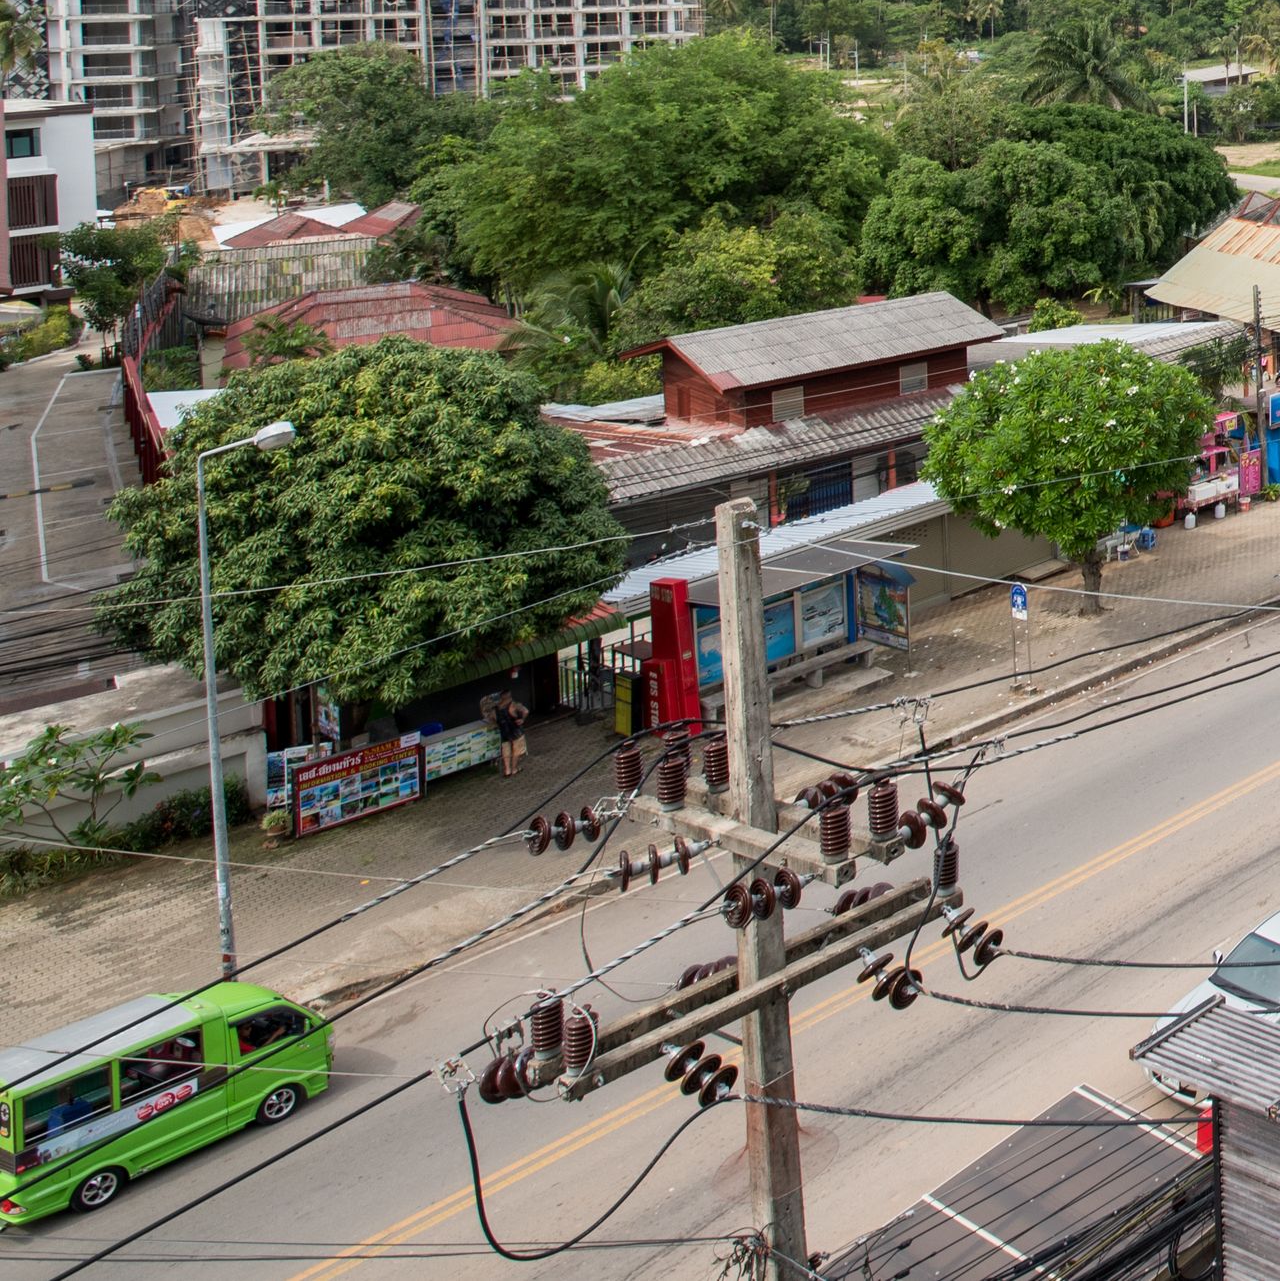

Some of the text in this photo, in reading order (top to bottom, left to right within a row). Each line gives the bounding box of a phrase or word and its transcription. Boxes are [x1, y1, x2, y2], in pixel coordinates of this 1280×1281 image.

[300, 769, 348, 790] INFORMATION
[360, 757, 389, 773] BOOKING
[391, 748, 417, 763] CENTRE
